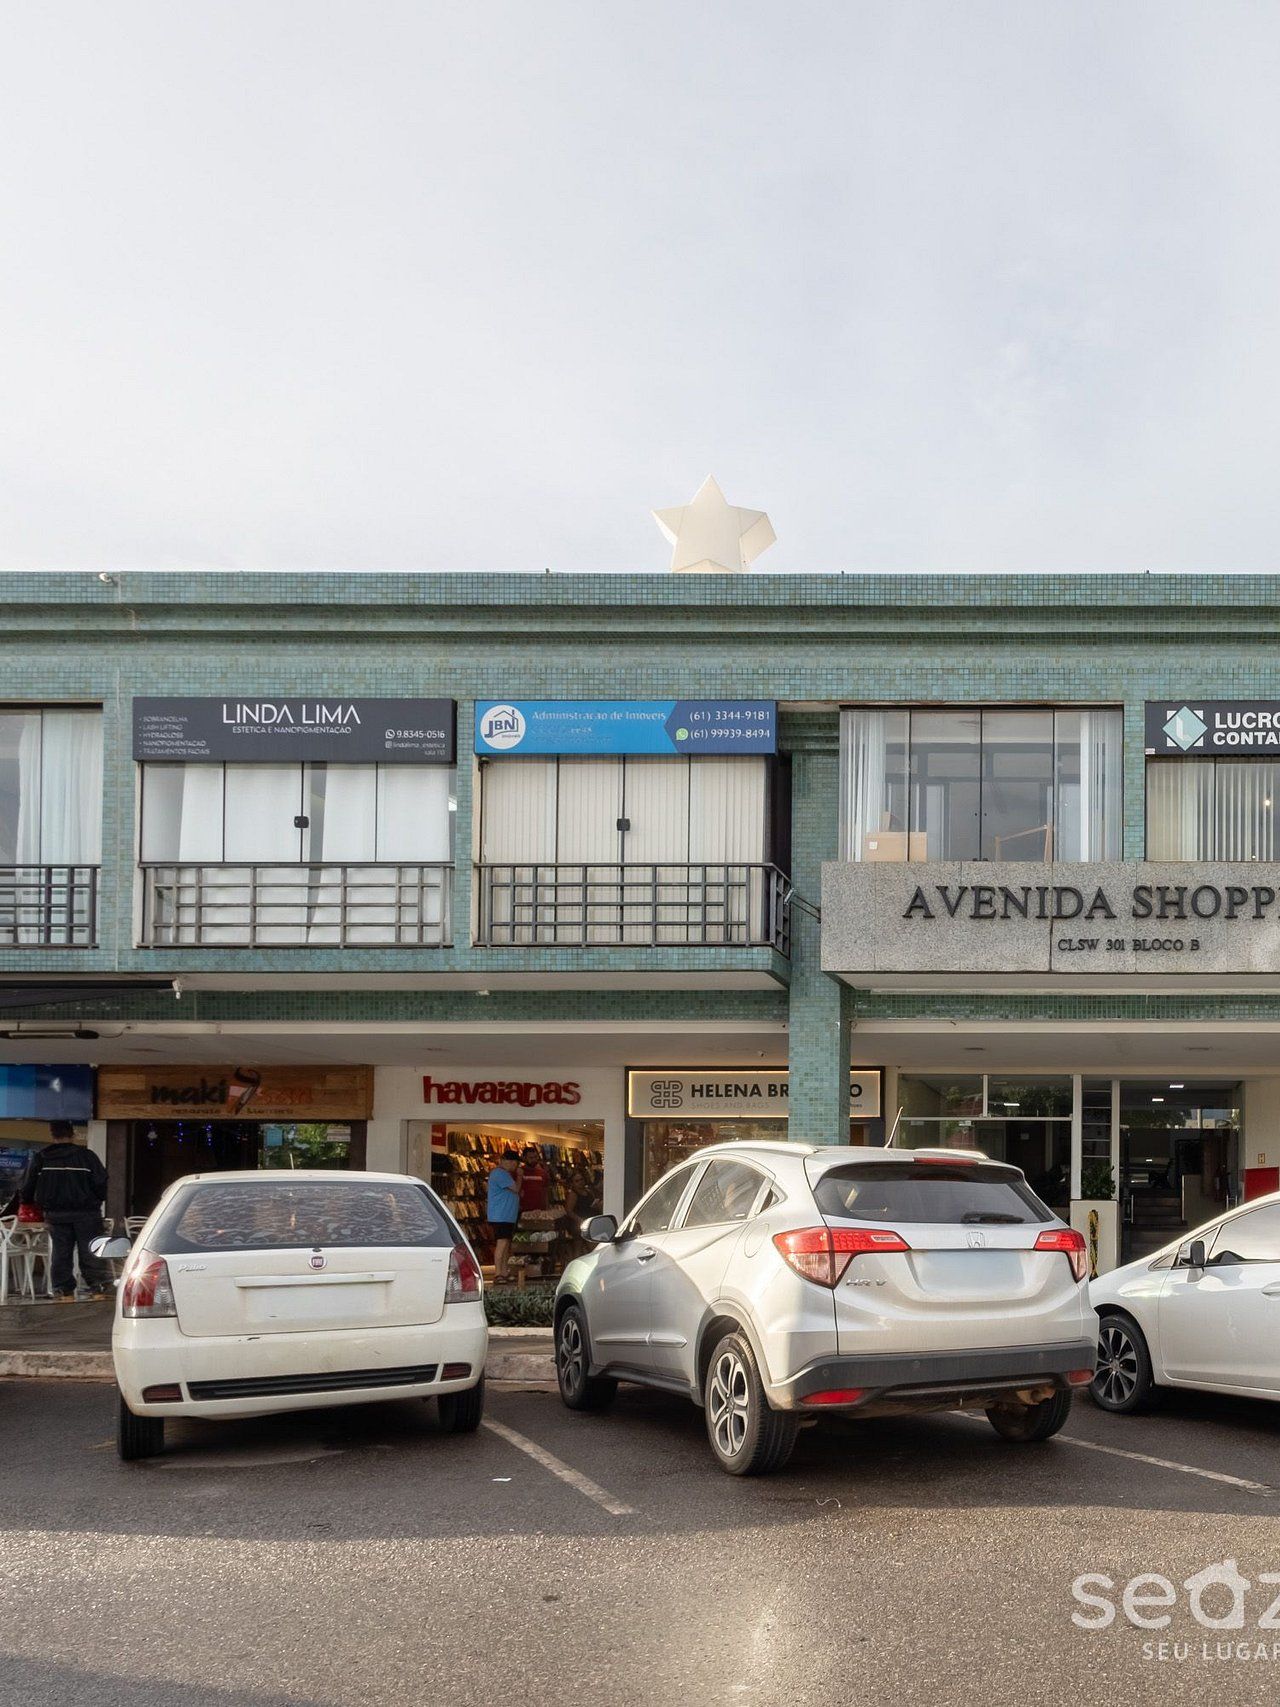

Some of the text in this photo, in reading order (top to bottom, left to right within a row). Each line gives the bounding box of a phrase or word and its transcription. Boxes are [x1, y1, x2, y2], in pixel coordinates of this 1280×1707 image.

[222, 704, 361, 724] LINDA LIMA
[609, 710, 623, 721] de
[689, 710, 770, 723] (61) 3344-9181
[484, 719, 516, 739] JBN
[690, 728, 770, 740] (61) 99939-8494
[902, 885, 1117, 920] AVENIDA
[1058, 938, 1200, 951] CLSW 301 BLOCO B
[150, 1078, 227, 1105] maki
[423, 1075, 582, 1107] havaianas
[691, 1083, 763, 1098] HELENA
